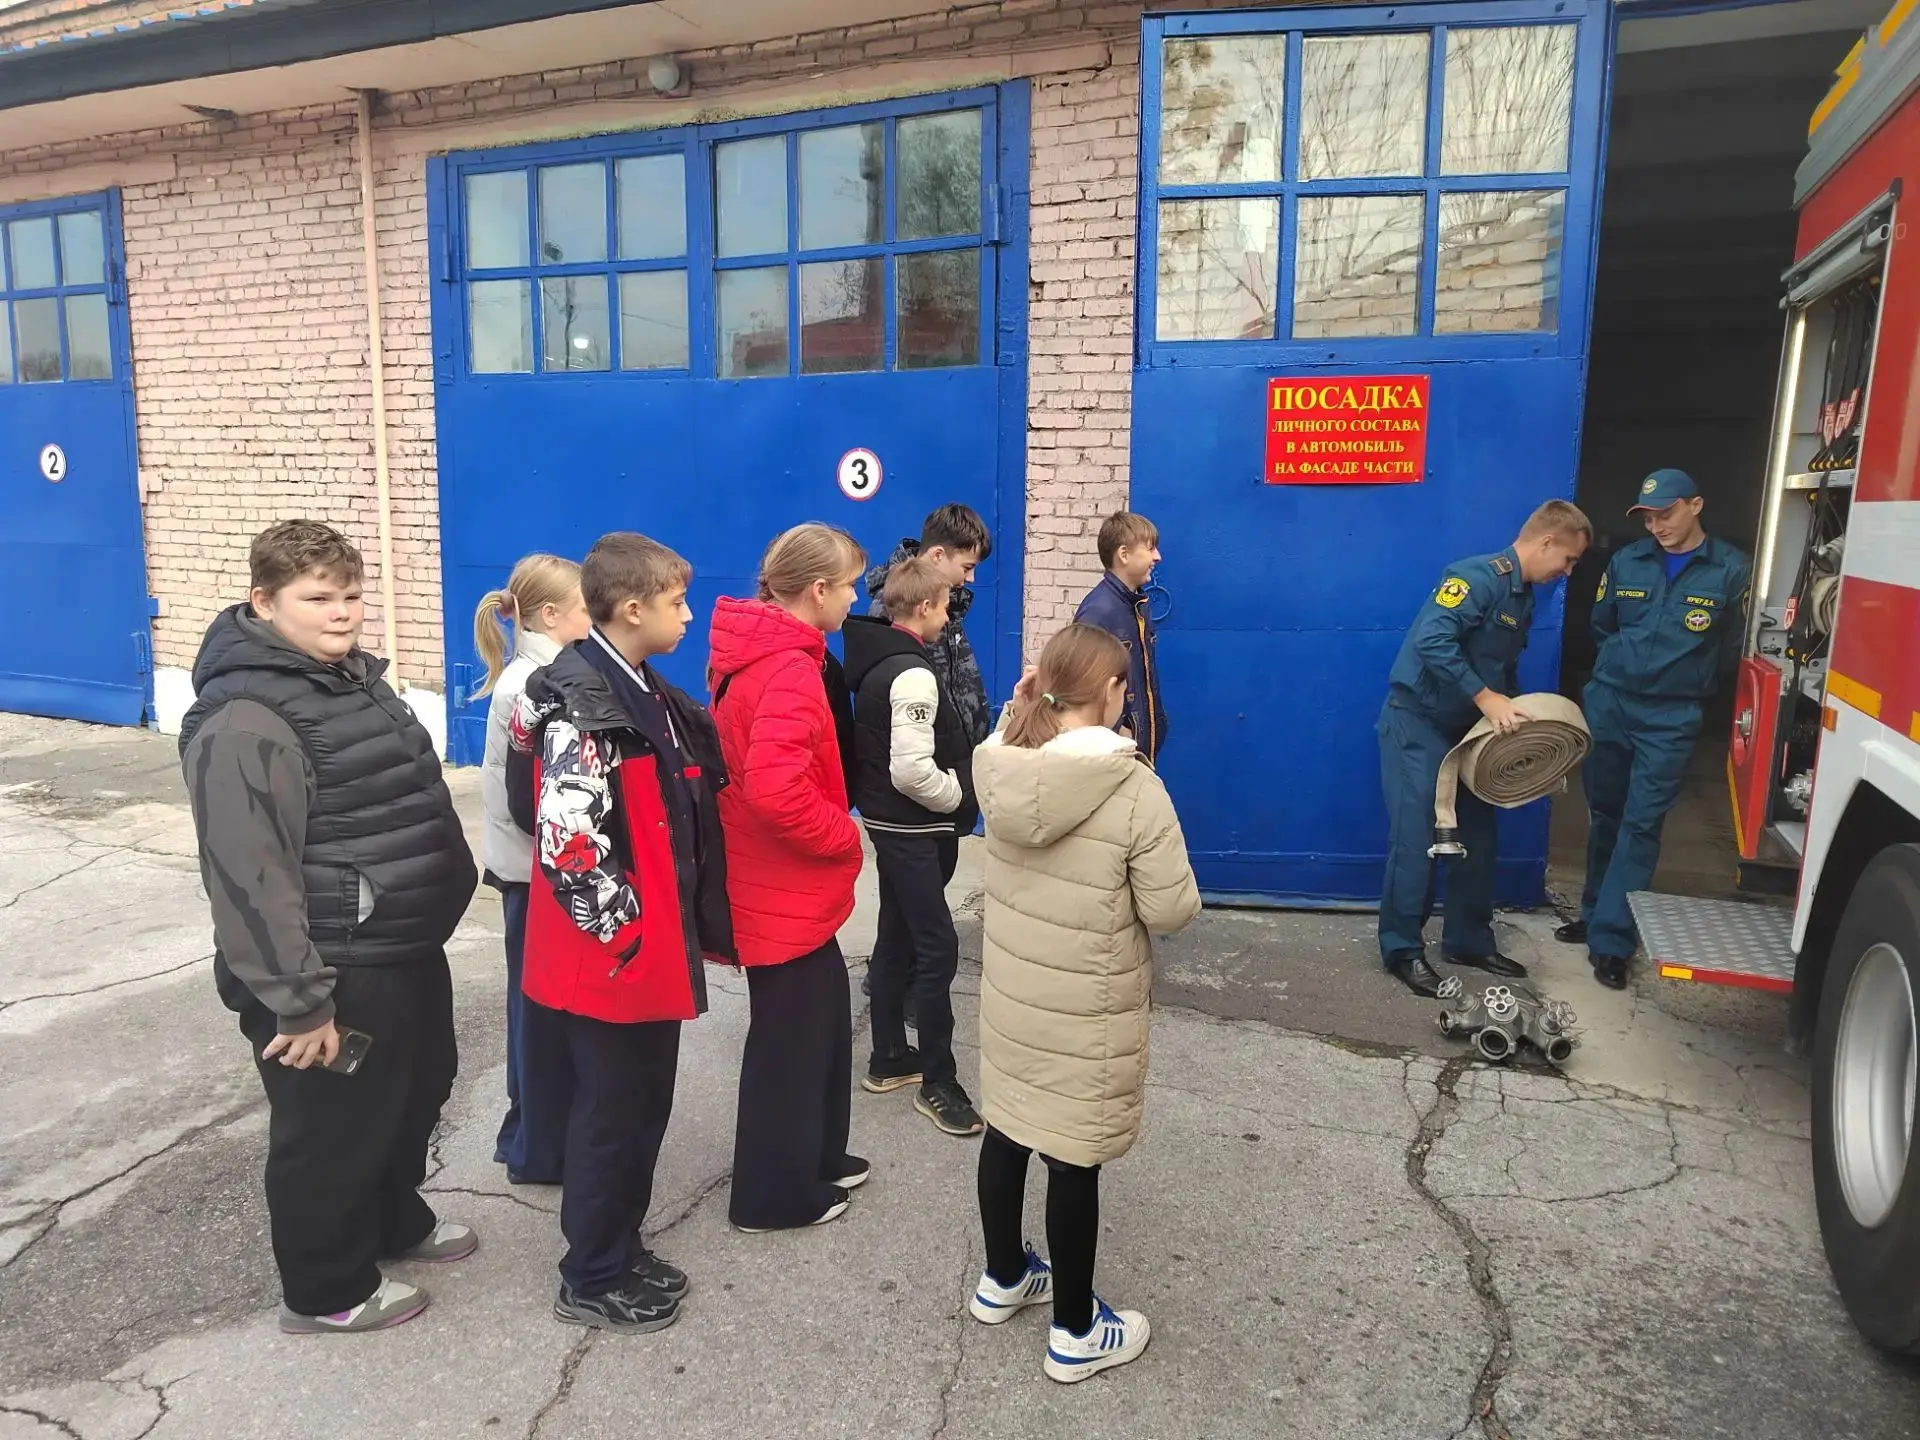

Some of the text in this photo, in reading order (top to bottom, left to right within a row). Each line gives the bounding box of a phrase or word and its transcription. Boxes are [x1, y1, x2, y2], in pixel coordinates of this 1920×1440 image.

[1272, 385, 1423, 414] ПОСАДКА
[1272, 419, 1421, 433] ЛИЧНОГО СОСТАВА
[1286, 440, 1404, 453] В АВТОМОБИЛЬ
[48, 451, 59, 474] 2
[1274, 461, 1414, 475] НА ФАСАДЕ ЧАСТИ
[851, 458, 869, 490] 3
